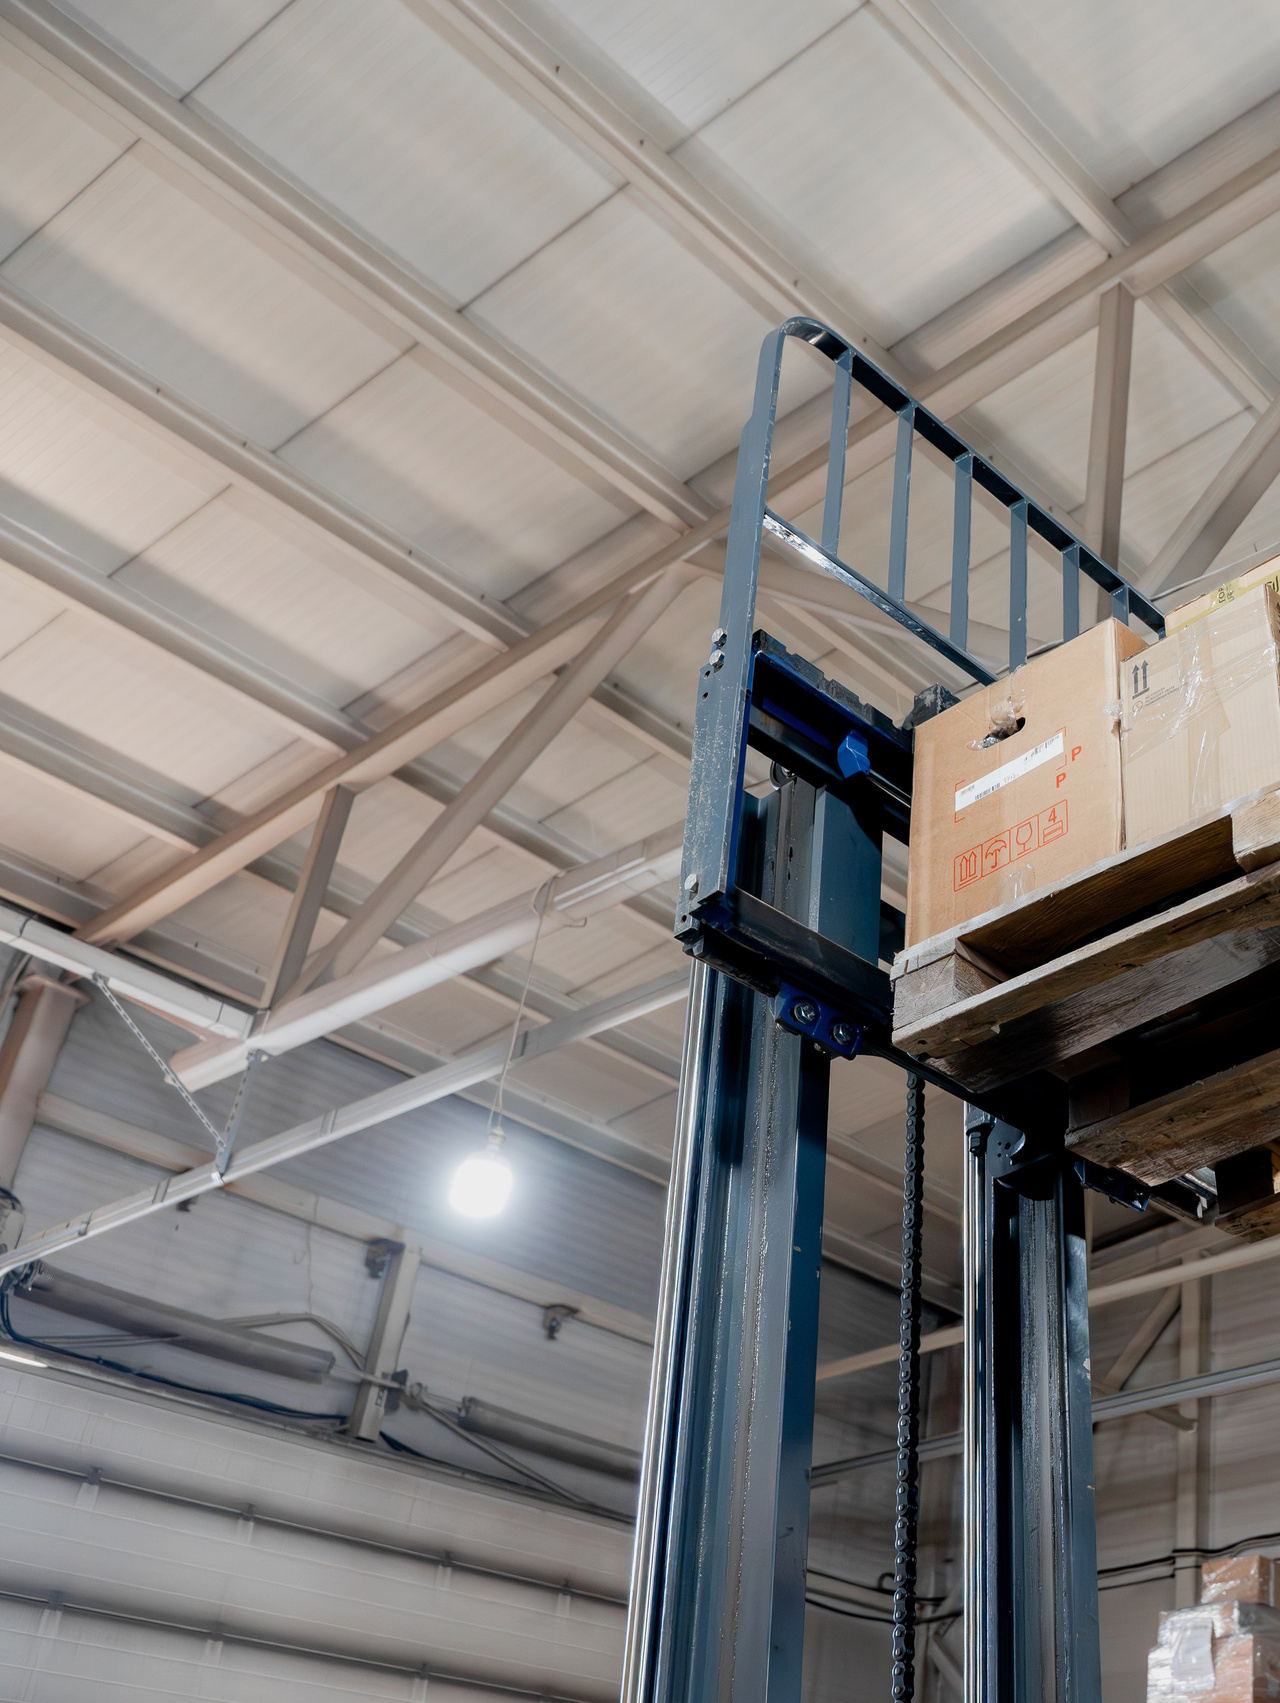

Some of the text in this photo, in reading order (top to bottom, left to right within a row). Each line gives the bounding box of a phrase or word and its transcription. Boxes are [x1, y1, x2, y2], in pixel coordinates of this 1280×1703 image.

[1072, 746, 1081, 761] P
[1056, 773, 1066, 788] P
[1048, 808, 1057, 823] 4
